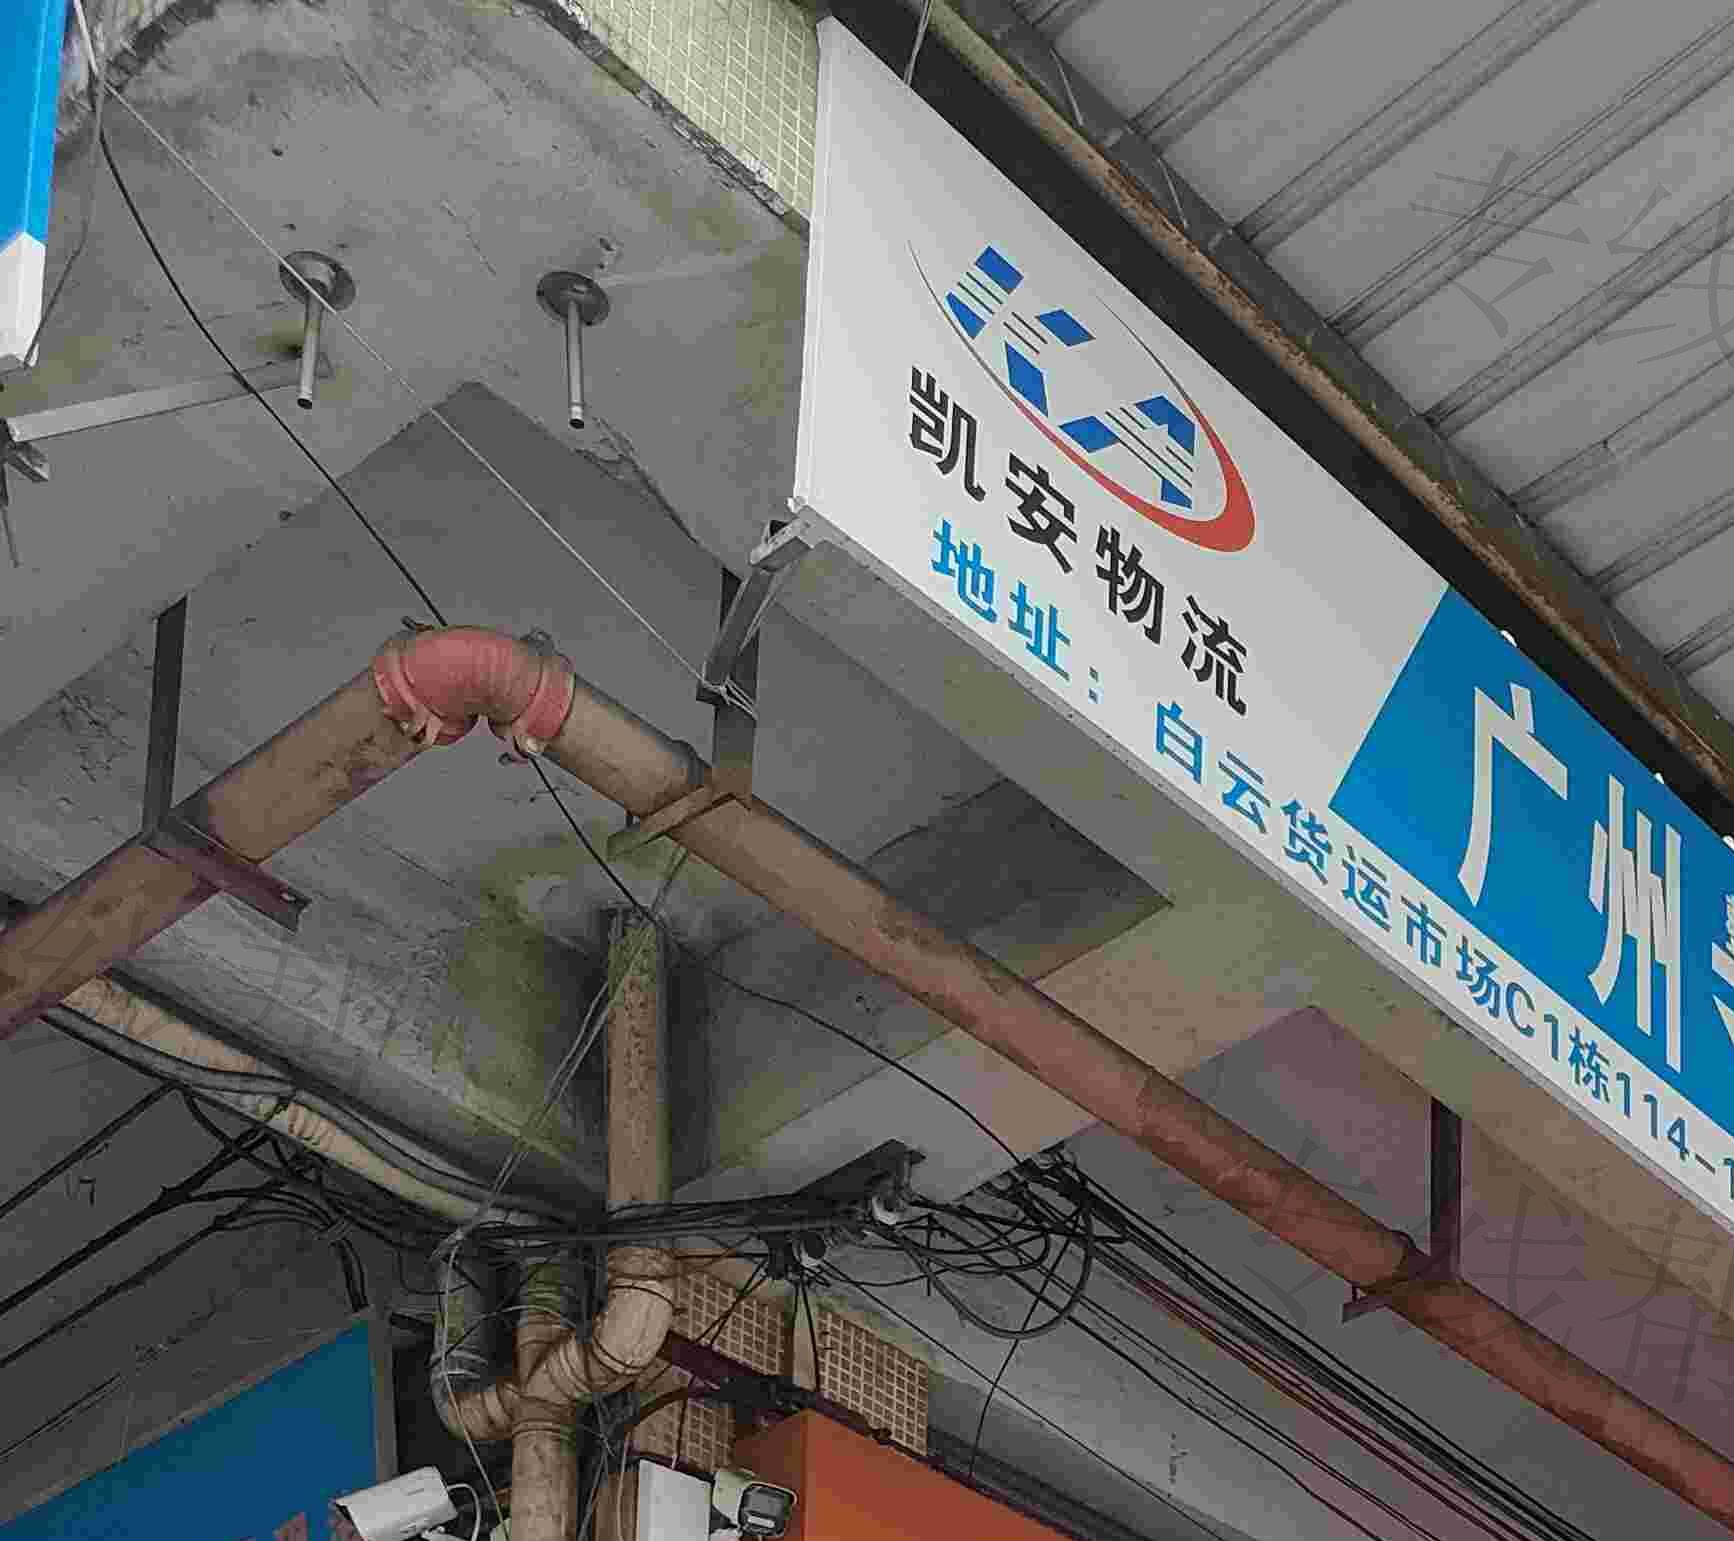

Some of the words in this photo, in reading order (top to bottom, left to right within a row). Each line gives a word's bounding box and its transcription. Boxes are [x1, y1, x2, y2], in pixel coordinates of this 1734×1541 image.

[908, 364, 1249, 717] 凯安物流
[1458, 682, 1683, 1075] 广州
